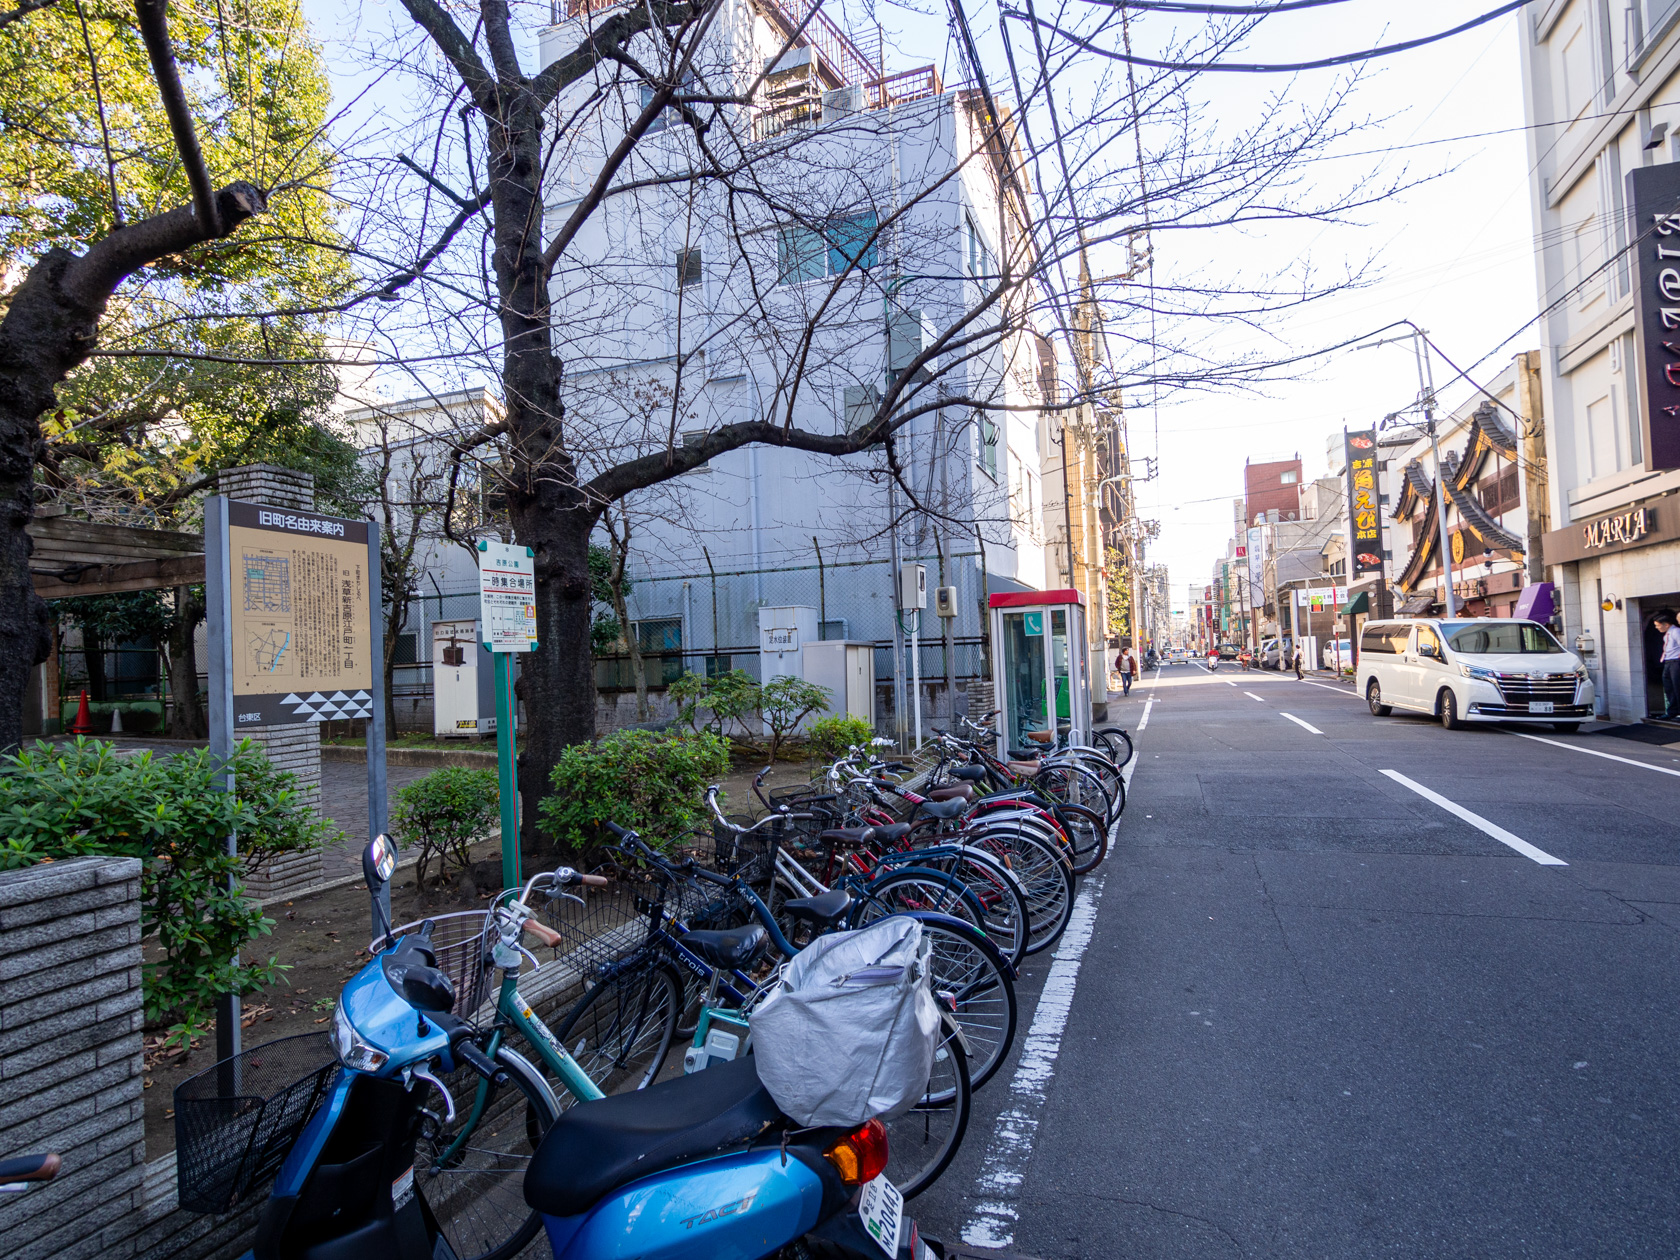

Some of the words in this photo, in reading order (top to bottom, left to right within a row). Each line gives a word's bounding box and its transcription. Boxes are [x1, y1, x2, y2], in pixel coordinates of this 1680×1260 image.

[1354, 469, 1377, 530] 角えび
[259, 510, 345, 537] 旧町名由来案内
[1356, 529, 1377, 539] 本店
[1583, 508, 1647, 549] MARIA
[483, 576, 533, 589] 一時集合場所
[238, 712, 261, 722] 台東区
[678, 952, 705, 977] trois
[680, 1195, 757, 1229] TACT
